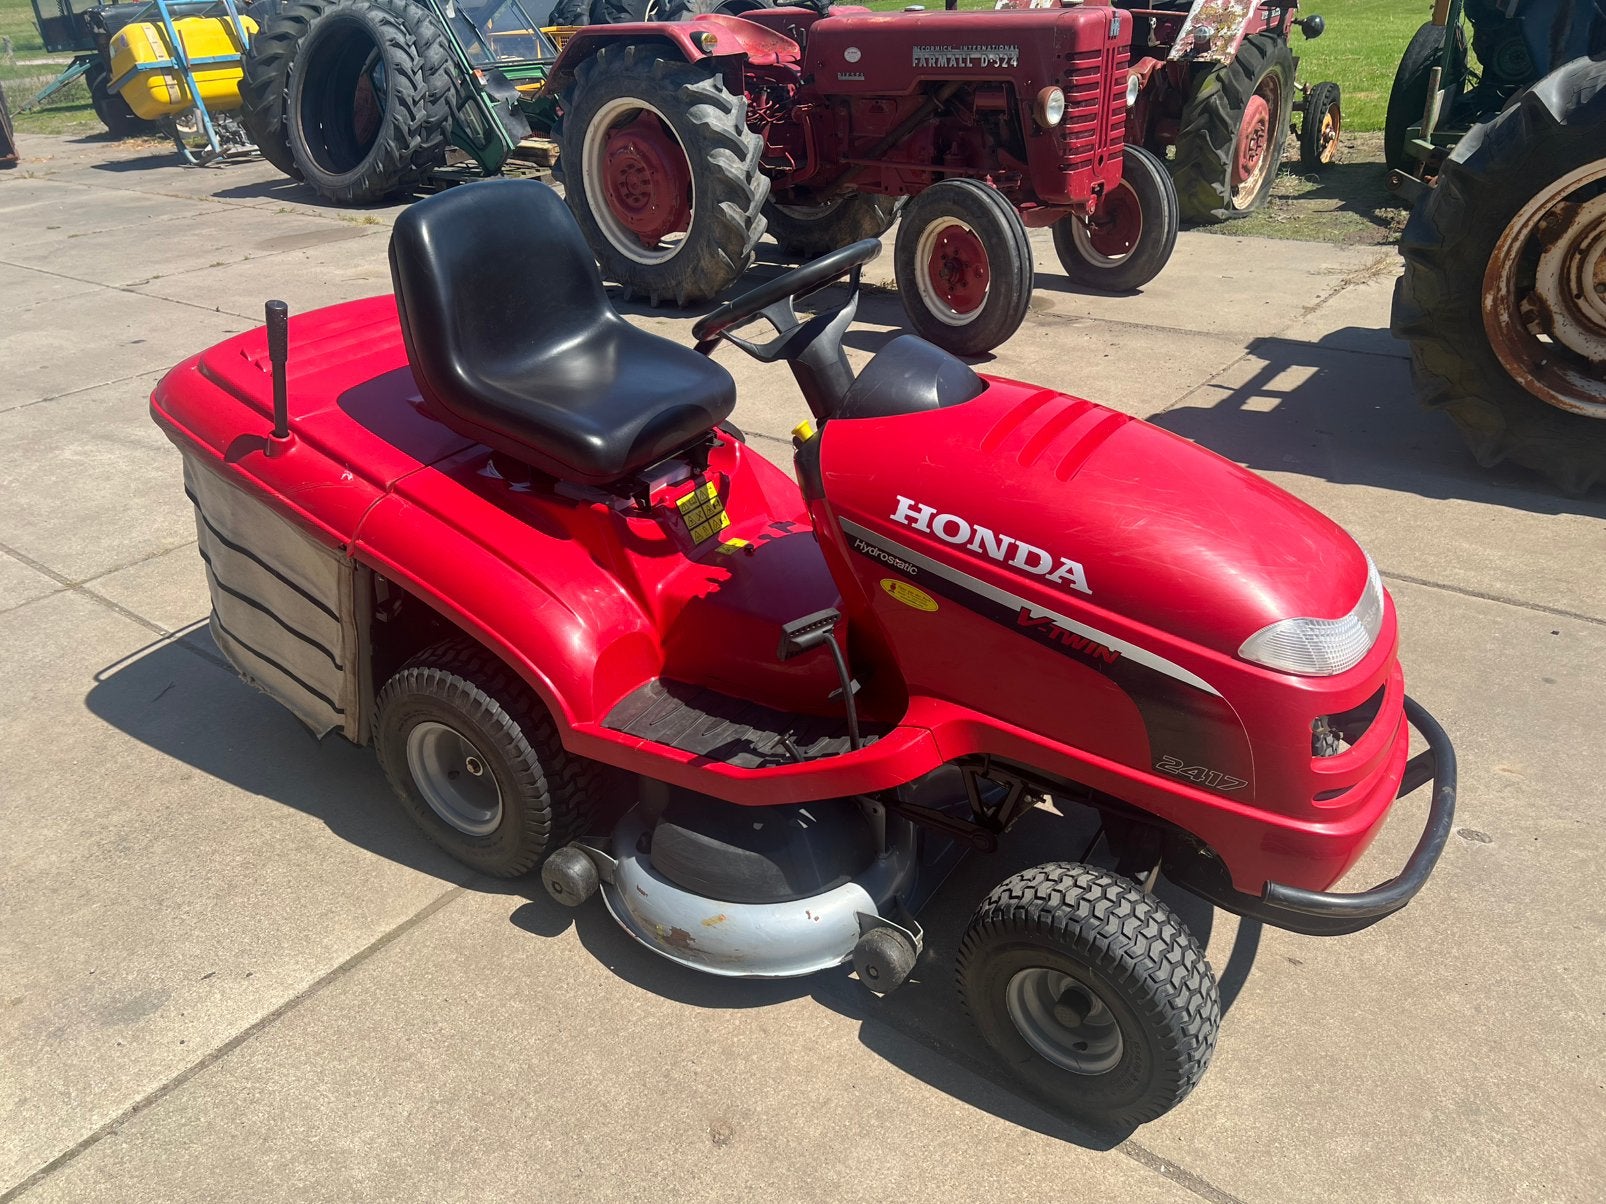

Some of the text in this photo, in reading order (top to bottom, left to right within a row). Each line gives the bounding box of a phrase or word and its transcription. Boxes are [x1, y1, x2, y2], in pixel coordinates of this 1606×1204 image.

[912, 54, 973, 67] FARMALL
[854, 539, 918, 575] Hydrostatic
[889, 495, 1093, 595] HONDA
[1017, 606, 1122, 665] V-TWIN
[1155, 754, 1249, 791] 2417
